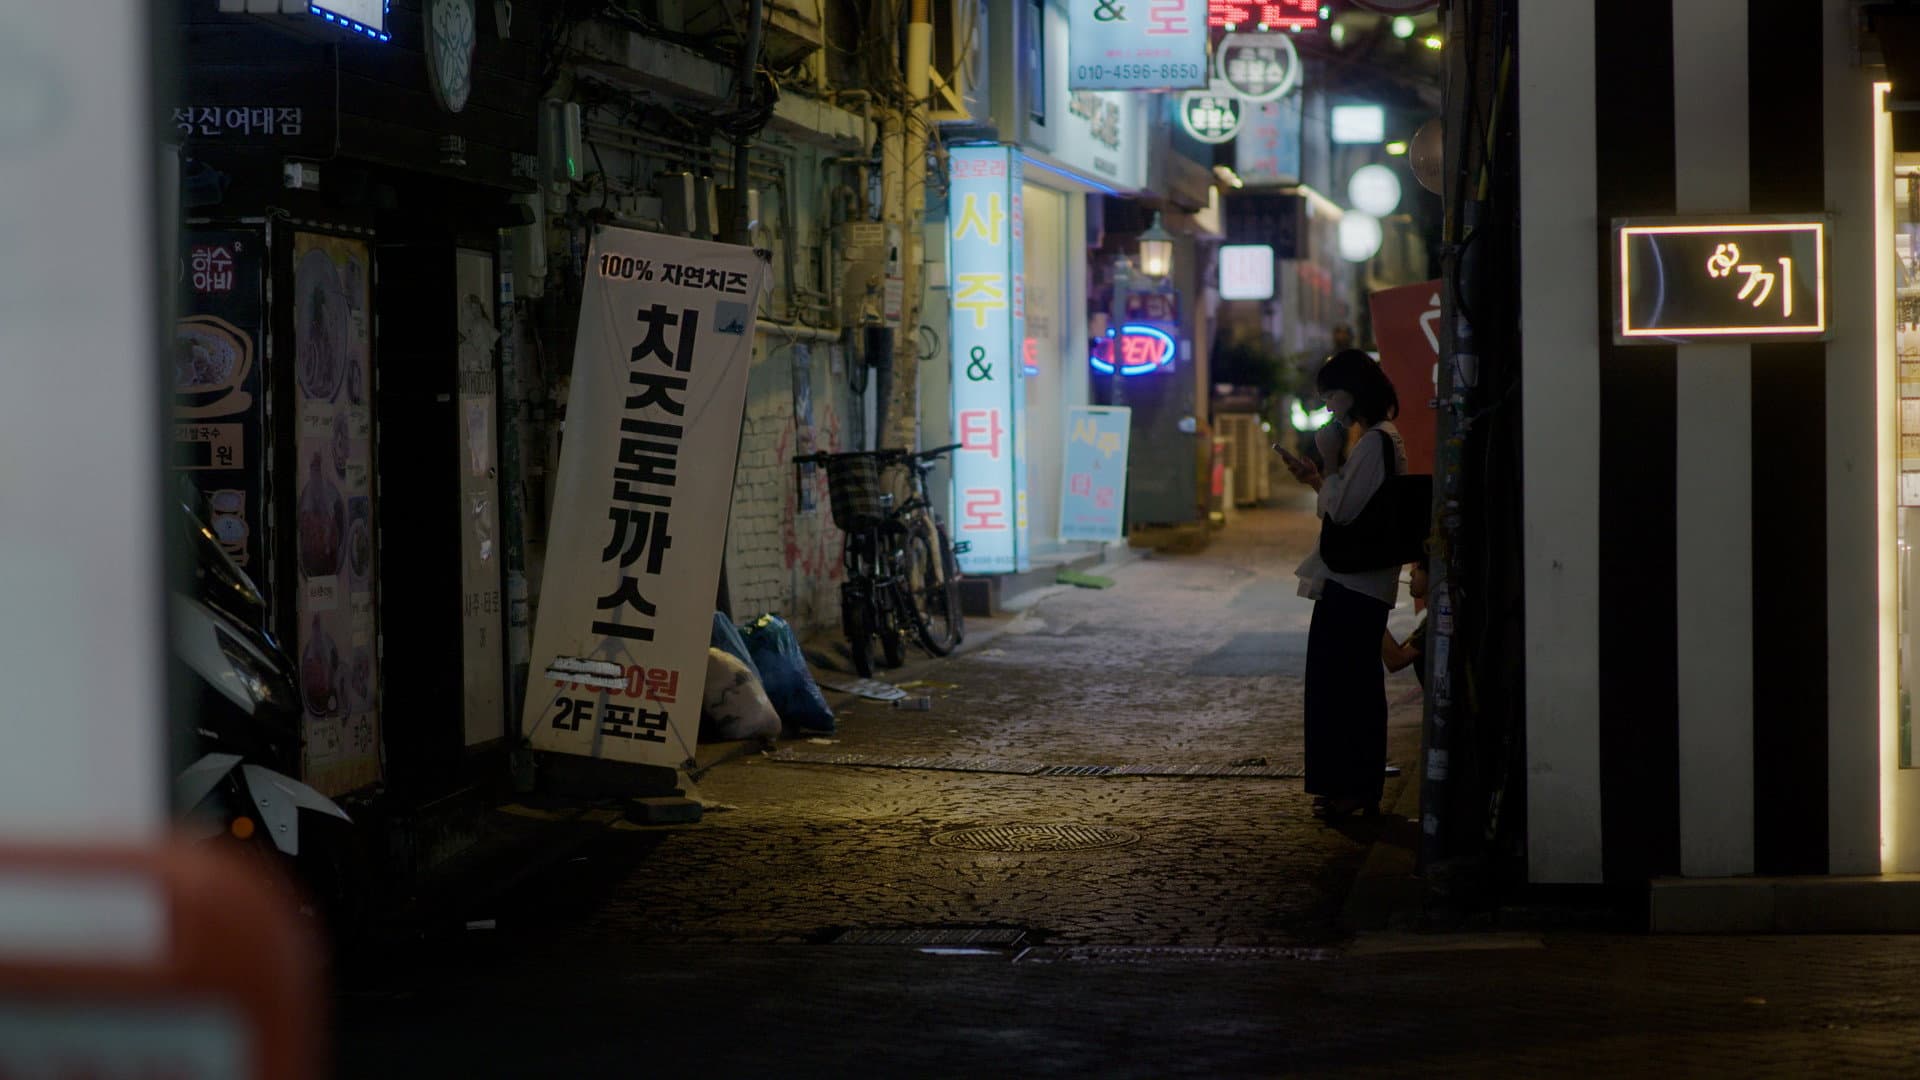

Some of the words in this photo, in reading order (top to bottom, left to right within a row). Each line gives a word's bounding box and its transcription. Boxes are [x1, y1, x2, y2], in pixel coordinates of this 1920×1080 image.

[1078, 64, 1198, 80] 010-4596-8650
[599, 254, 653, 281] 100%
[660, 263, 748, 295] 자연치즈
[966, 346, 995, 382] &
[591, 303, 699, 641] 치즈돈까스
[552, 697, 593, 731] 2F
[600, 703, 668, 743] 포보
